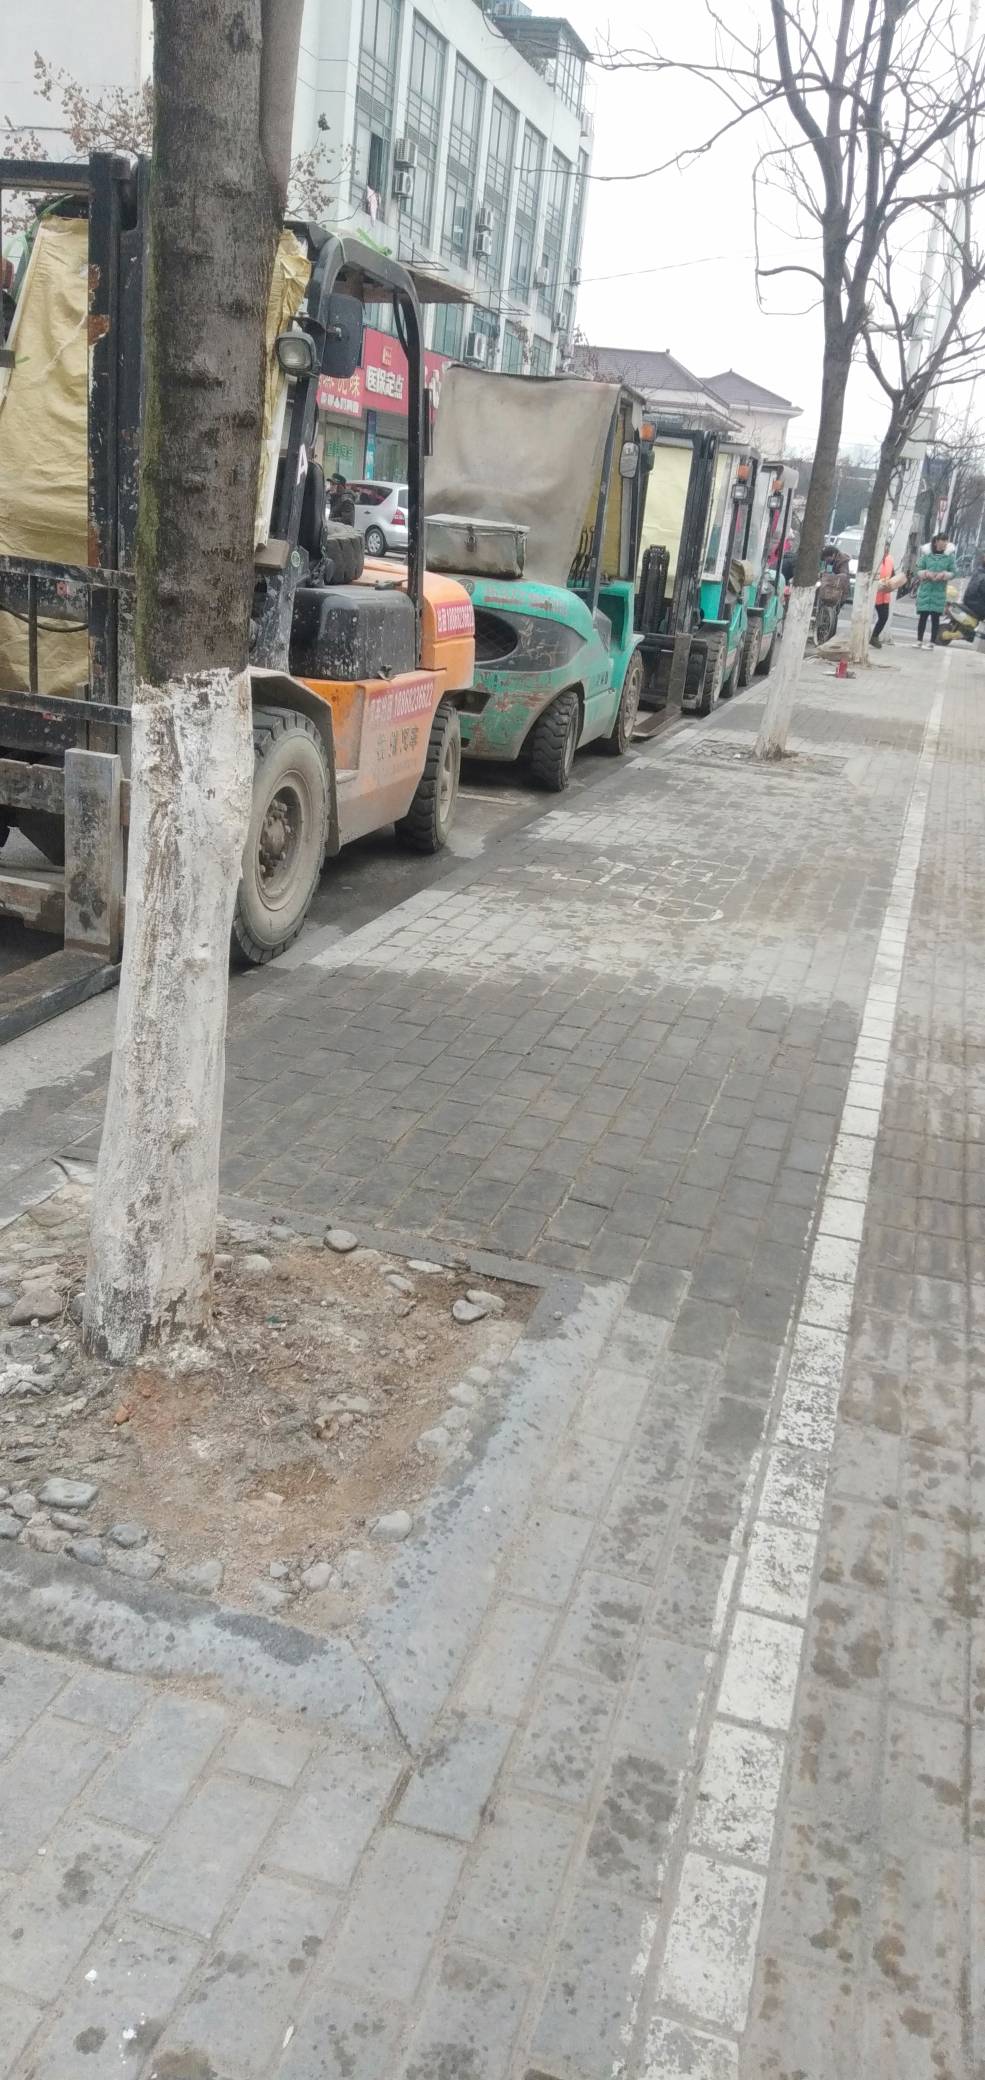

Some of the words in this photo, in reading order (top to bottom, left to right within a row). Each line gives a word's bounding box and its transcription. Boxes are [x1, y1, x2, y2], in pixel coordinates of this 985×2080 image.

[366, 366, 404, 400] 医保定点
[296, 443, 308, 484] A
